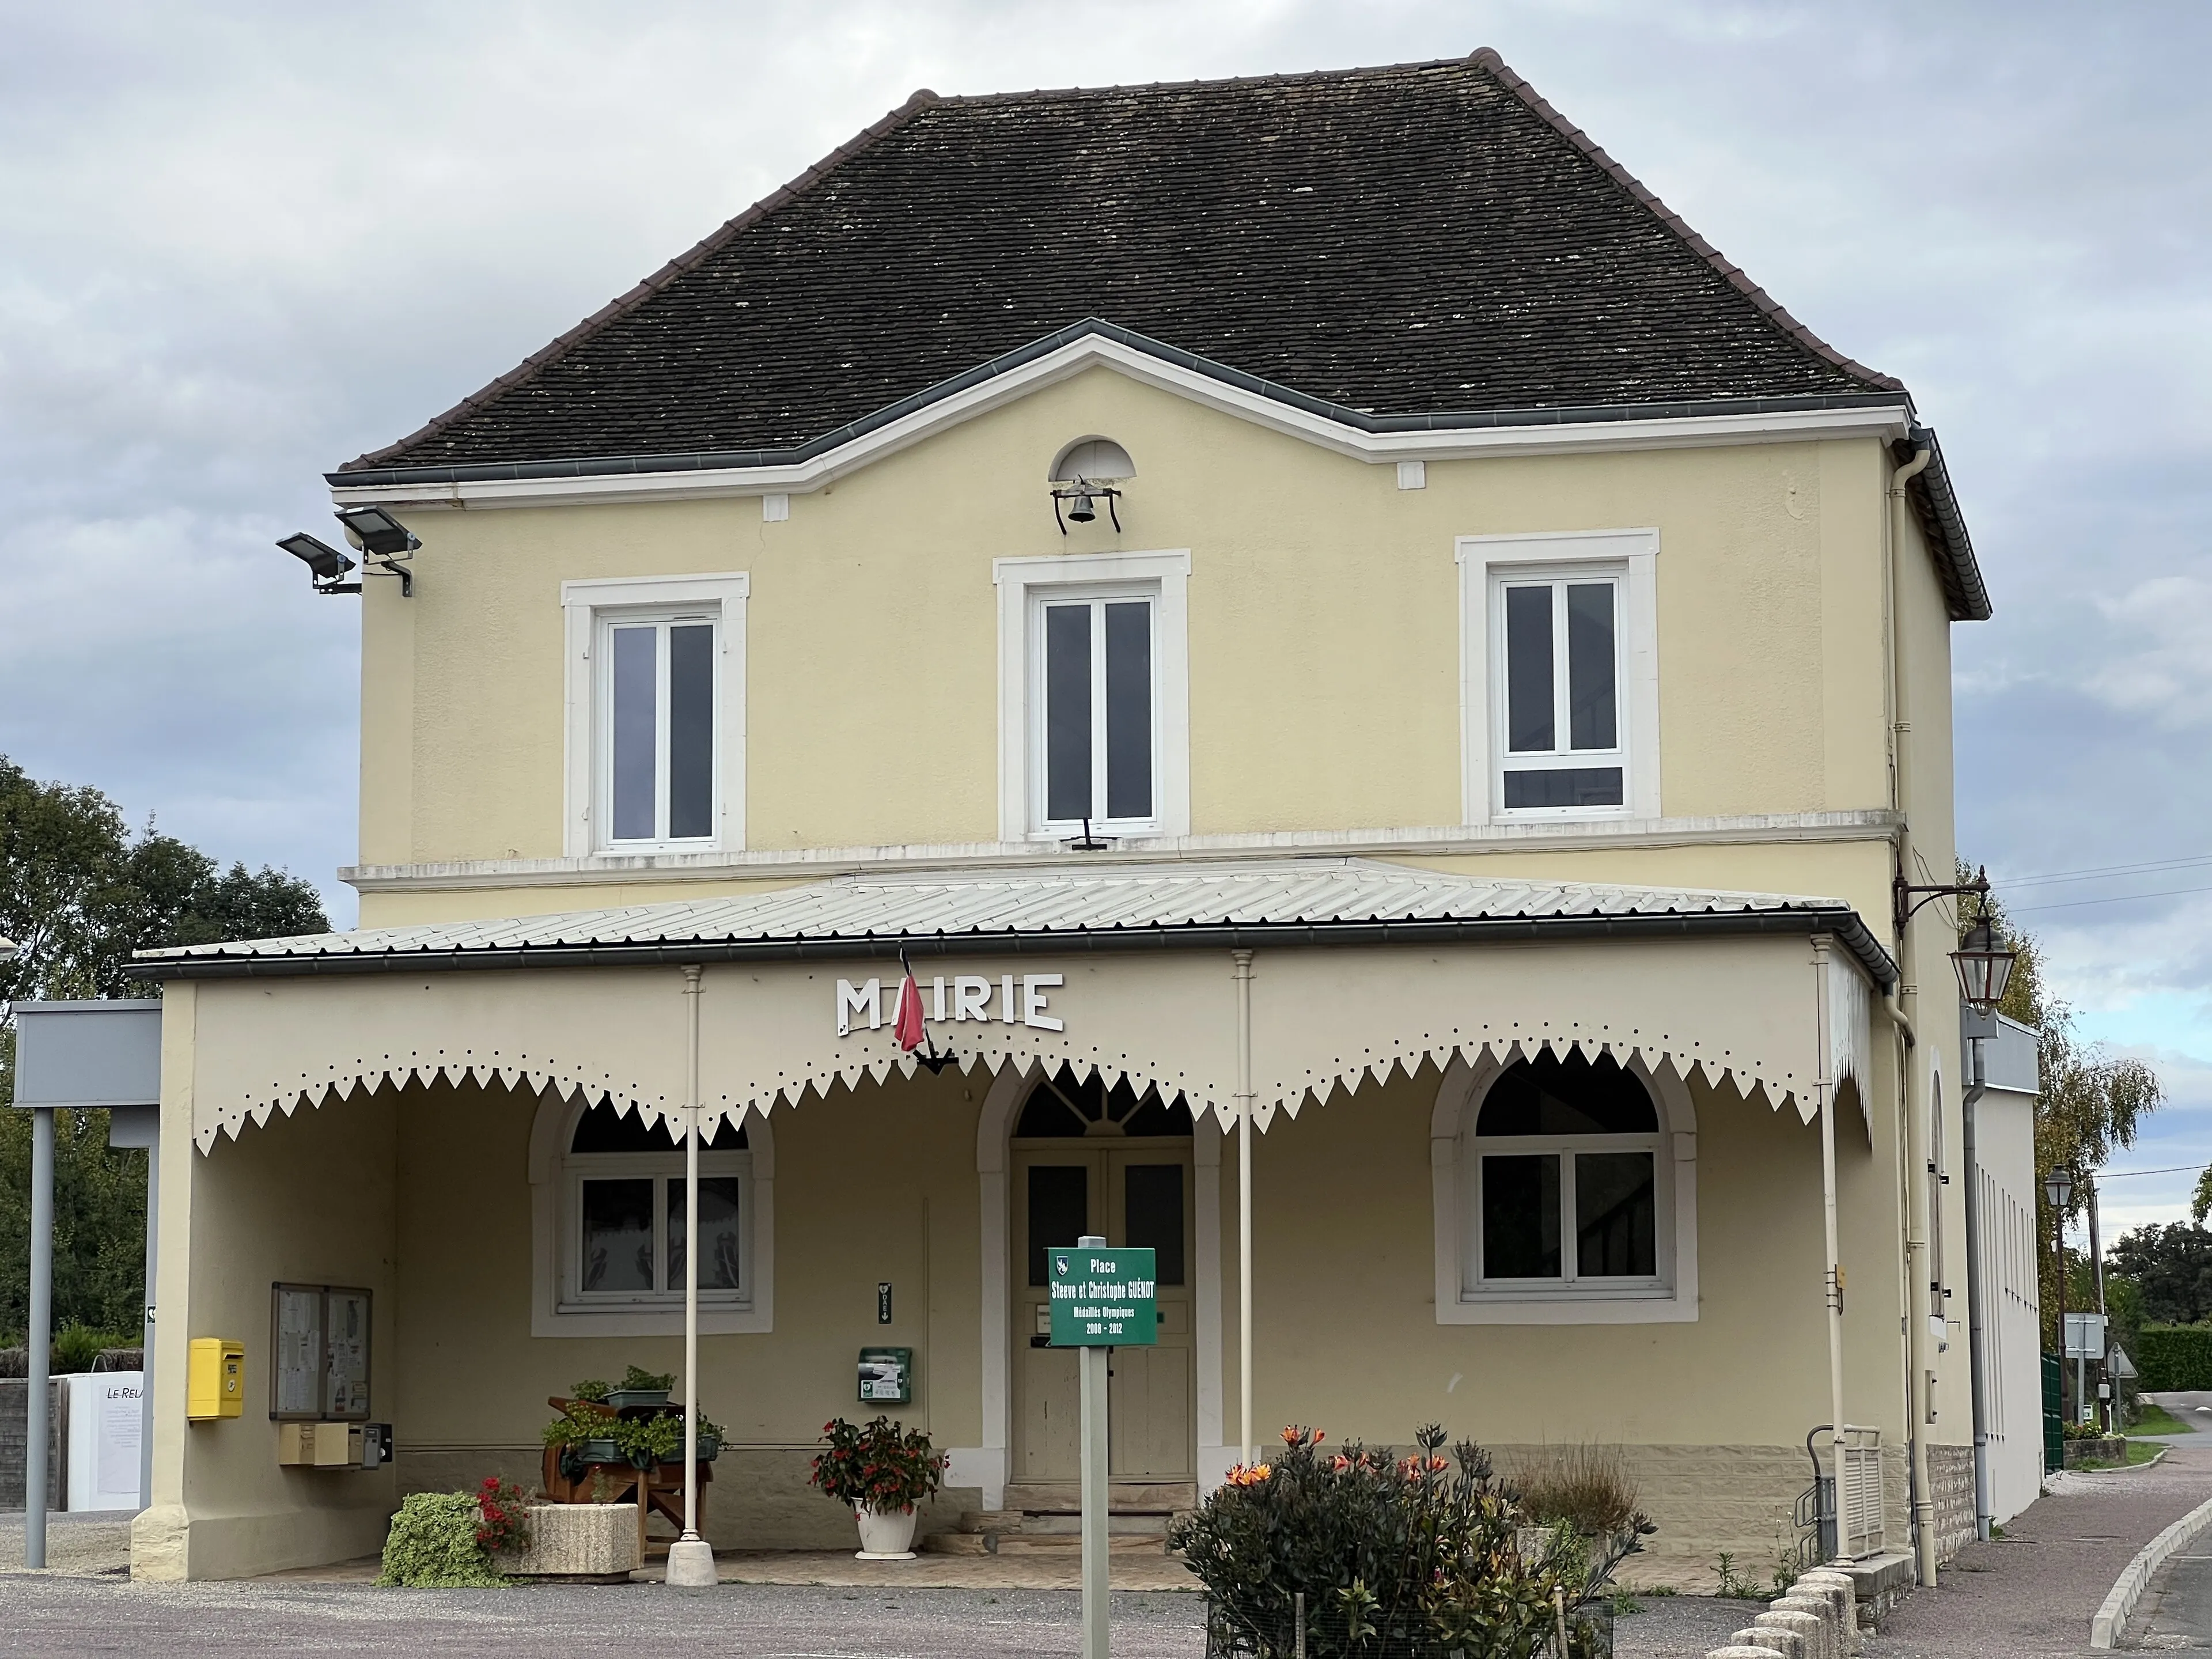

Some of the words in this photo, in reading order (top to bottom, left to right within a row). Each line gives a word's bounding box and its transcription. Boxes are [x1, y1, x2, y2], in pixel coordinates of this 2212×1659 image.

[1090, 1259, 1116, 1274] Place
[1051, 1281, 1076, 1299] Steeve
[1078, 1281, 1086, 1299] et
[1088, 1281, 1126, 1301] Christophe
[1128, 1277, 1154, 1299] GUÉNOT
[1073, 1306, 1101, 1318] Médaillés
[1103, 1306, 1135, 1319] Olympiques
[1086, 1323, 1102, 1335] 2008
[1109, 1323, 1123, 1334] 2012
[107, 1388, 119, 1399] LE
